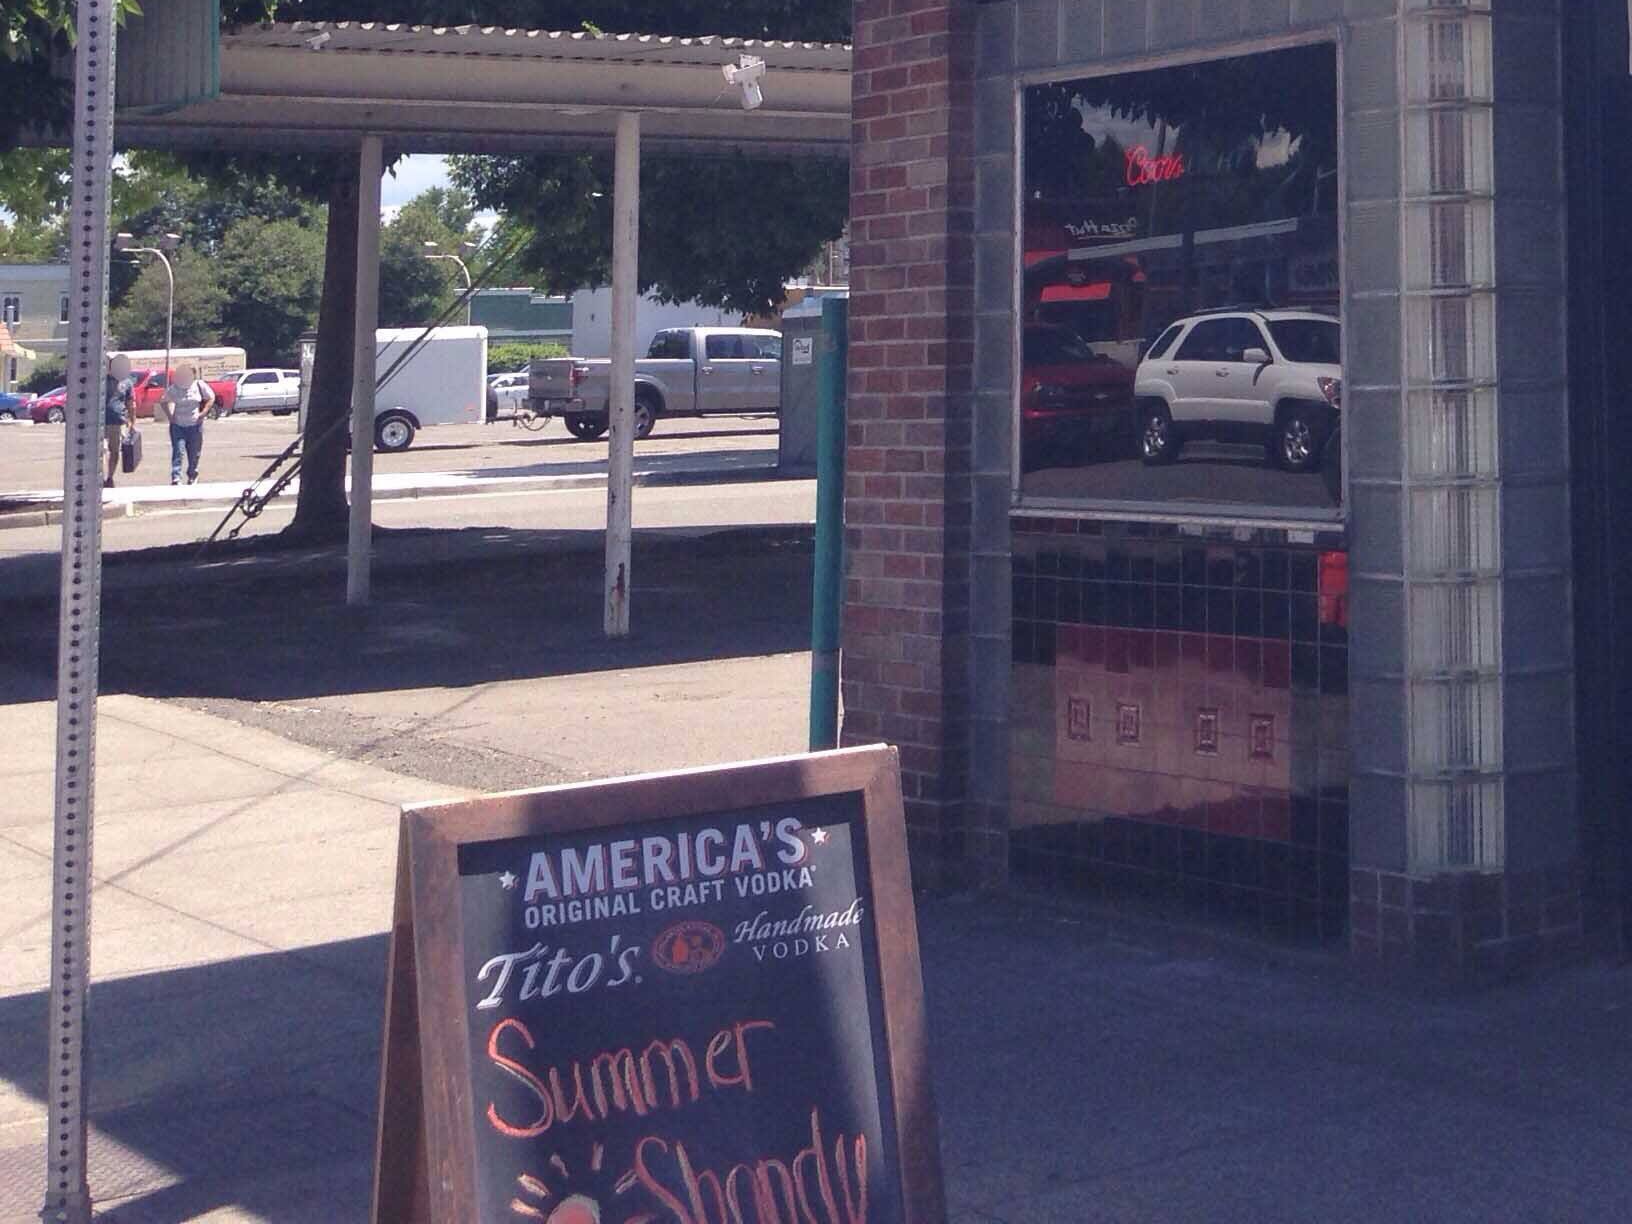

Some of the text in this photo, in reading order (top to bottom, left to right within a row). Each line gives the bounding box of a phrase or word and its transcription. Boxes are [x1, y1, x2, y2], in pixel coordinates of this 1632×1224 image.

[523, 816, 808, 903] AMERICA'S
[524, 869, 814, 929] ORIGINAL CRAFT VODKA
[734, 897, 865, 944] Handmade
[476, 934, 642, 1011] Tito's
[752, 933, 851, 962] VODKA
[486, 1017, 776, 1137] Summer
[625, 1106, 867, 1224] Shandy
